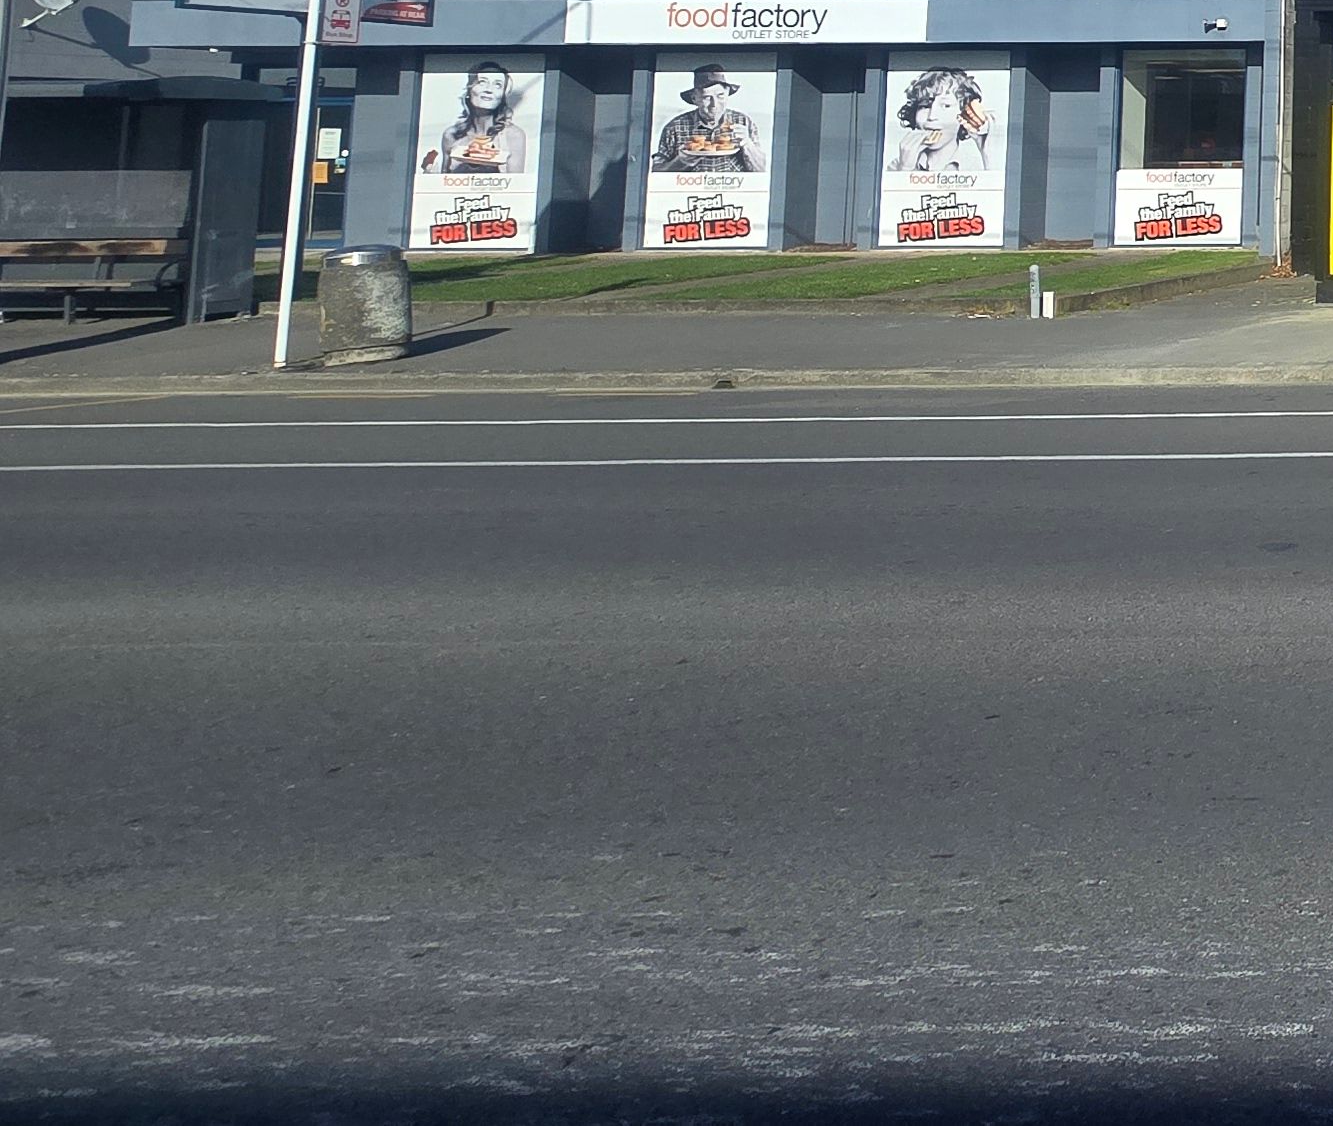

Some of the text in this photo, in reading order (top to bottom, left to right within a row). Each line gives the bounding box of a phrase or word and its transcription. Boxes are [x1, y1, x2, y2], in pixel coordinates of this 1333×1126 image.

[732, 30, 810, 39] OUTLET STORE
[455, 195, 490, 210] Feed
[687, 194, 722, 210] Feed
[921, 192, 956, 209] Feed
[1158, 191, 1193, 207] Feed
[435, 206, 510, 225] the Family
[668, 204, 743, 224] the Family
[901, 203, 977, 223] the Family
[1138, 202, 1215, 221] the Family
[430, 218, 517, 244] FOR LESS
[663, 217, 750, 244] FOR LESS
[897, 216, 985, 243] FOR LESS
[1134, 214, 1222, 241] FOR LESS
